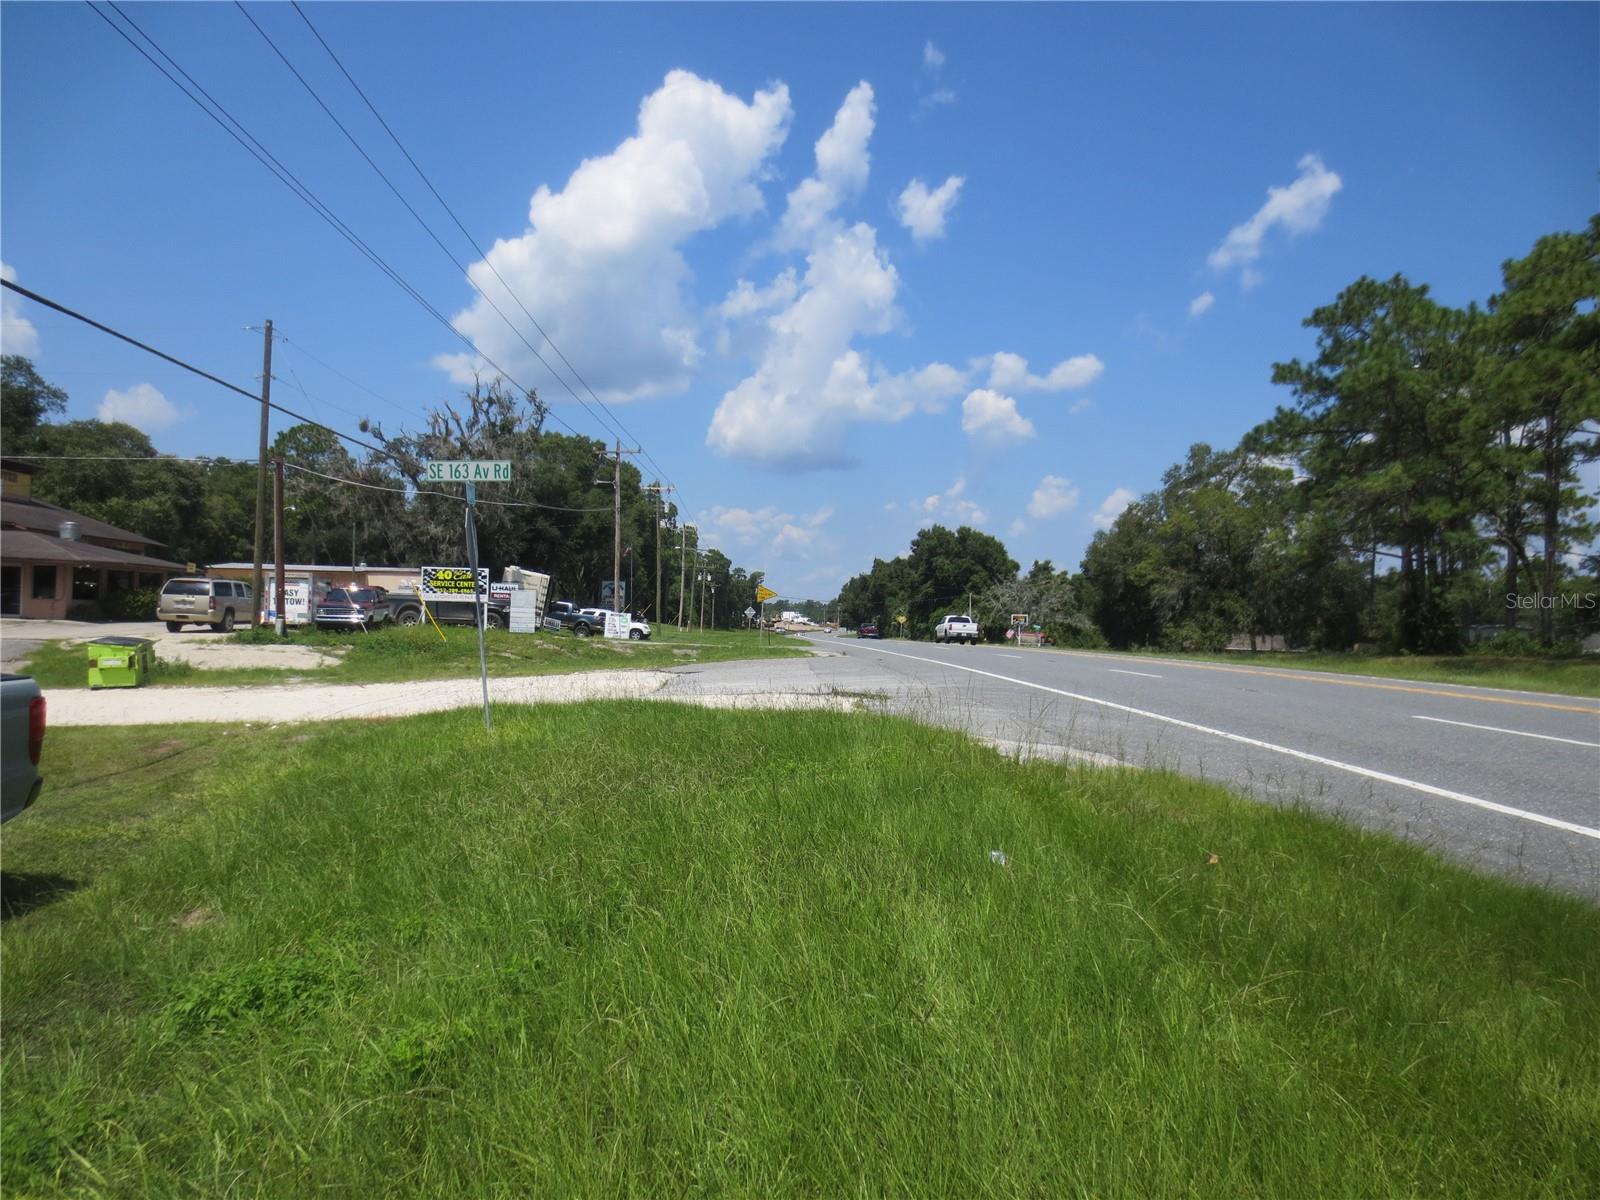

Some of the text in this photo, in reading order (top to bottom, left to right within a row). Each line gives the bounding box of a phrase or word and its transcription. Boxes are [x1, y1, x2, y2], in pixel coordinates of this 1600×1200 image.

[429, 463, 509, 479] SE 163 Av Rd
[437, 570, 453, 580] 40
[431, 580, 456, 588] SERVICE
